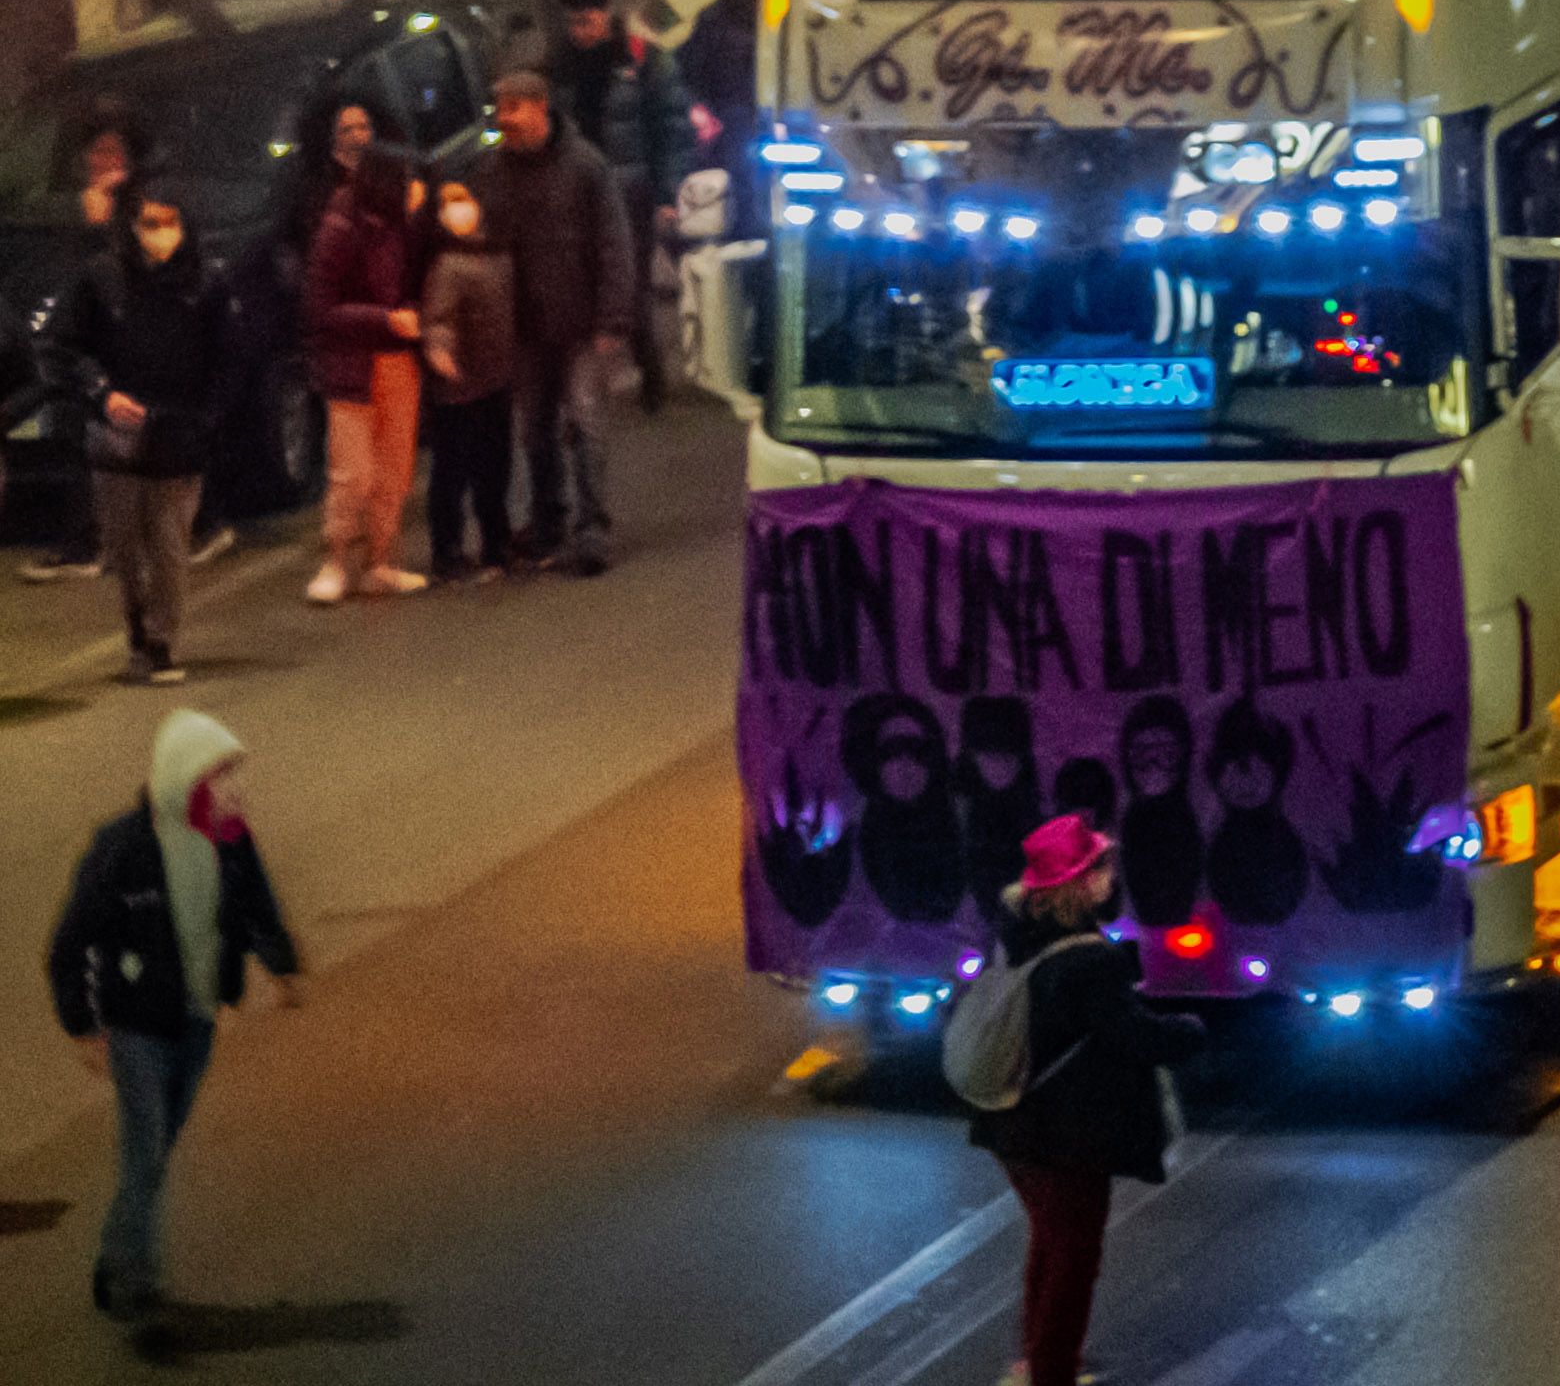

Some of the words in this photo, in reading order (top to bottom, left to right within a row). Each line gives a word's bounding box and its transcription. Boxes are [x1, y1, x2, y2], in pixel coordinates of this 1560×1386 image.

[747, 515, 896, 693] NON
[922, 525, 1085, 697] UNA
[1101, 525, 1181, 695] DI
[1202, 510, 1409, 697] MENO
